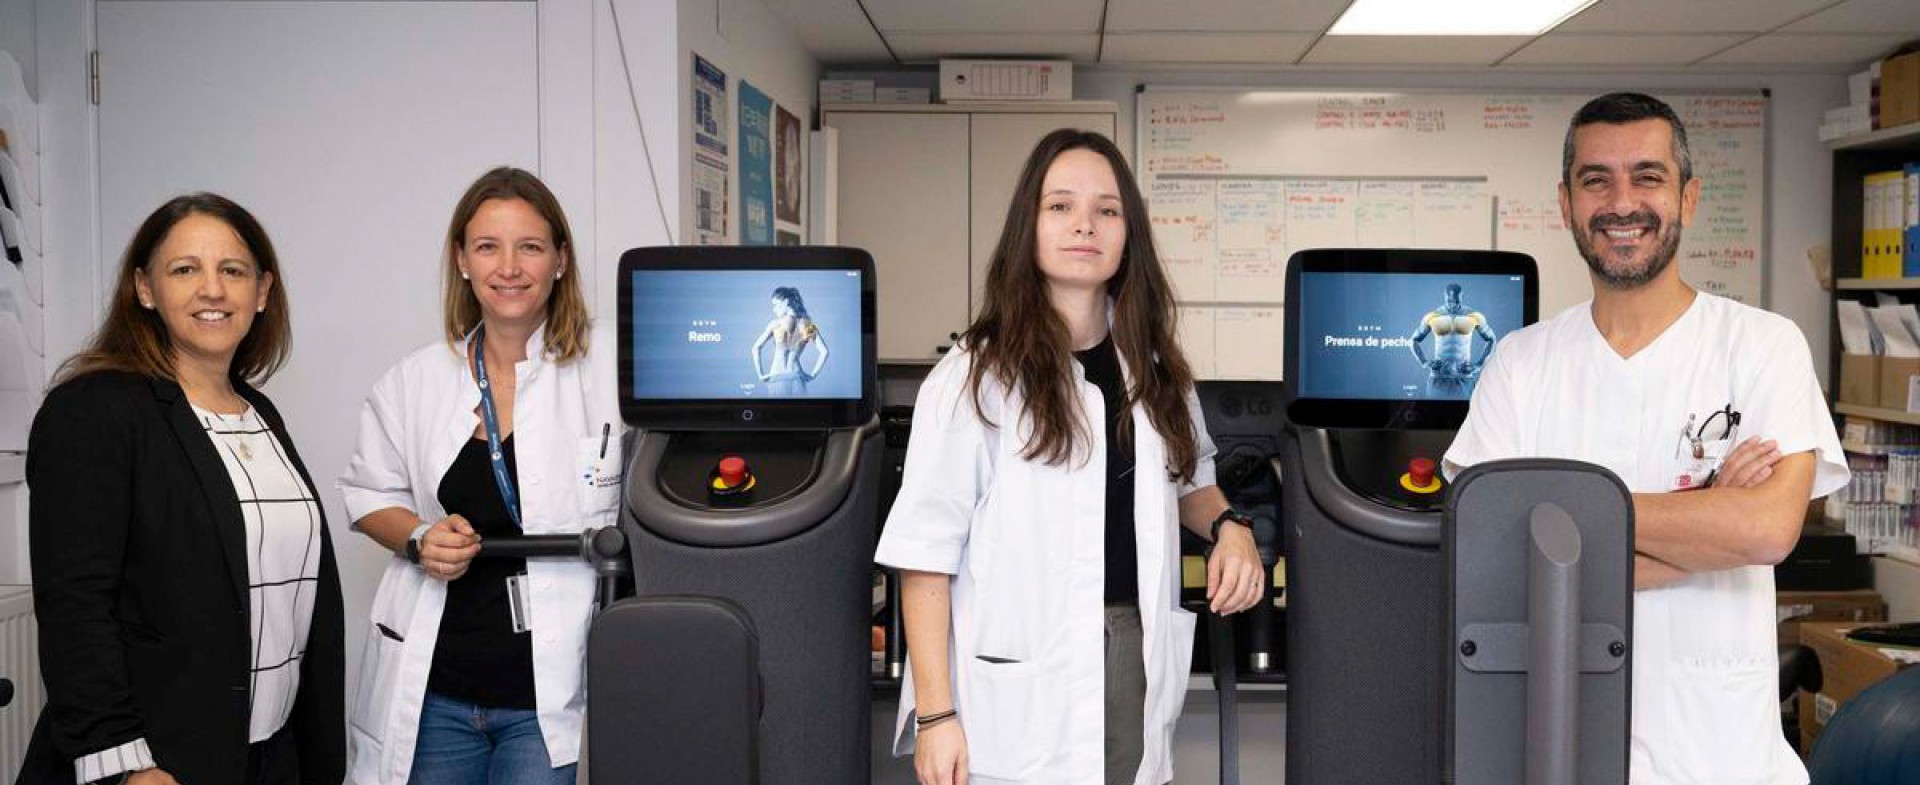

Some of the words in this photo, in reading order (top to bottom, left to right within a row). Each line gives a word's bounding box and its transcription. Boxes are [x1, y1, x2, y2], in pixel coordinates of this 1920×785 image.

[688, 331, 721, 342] Remo
[1324, 335, 1363, 347] Prensa
[1365, 335, 1379, 347] de
[1247, 399, 1273, 415] LG
